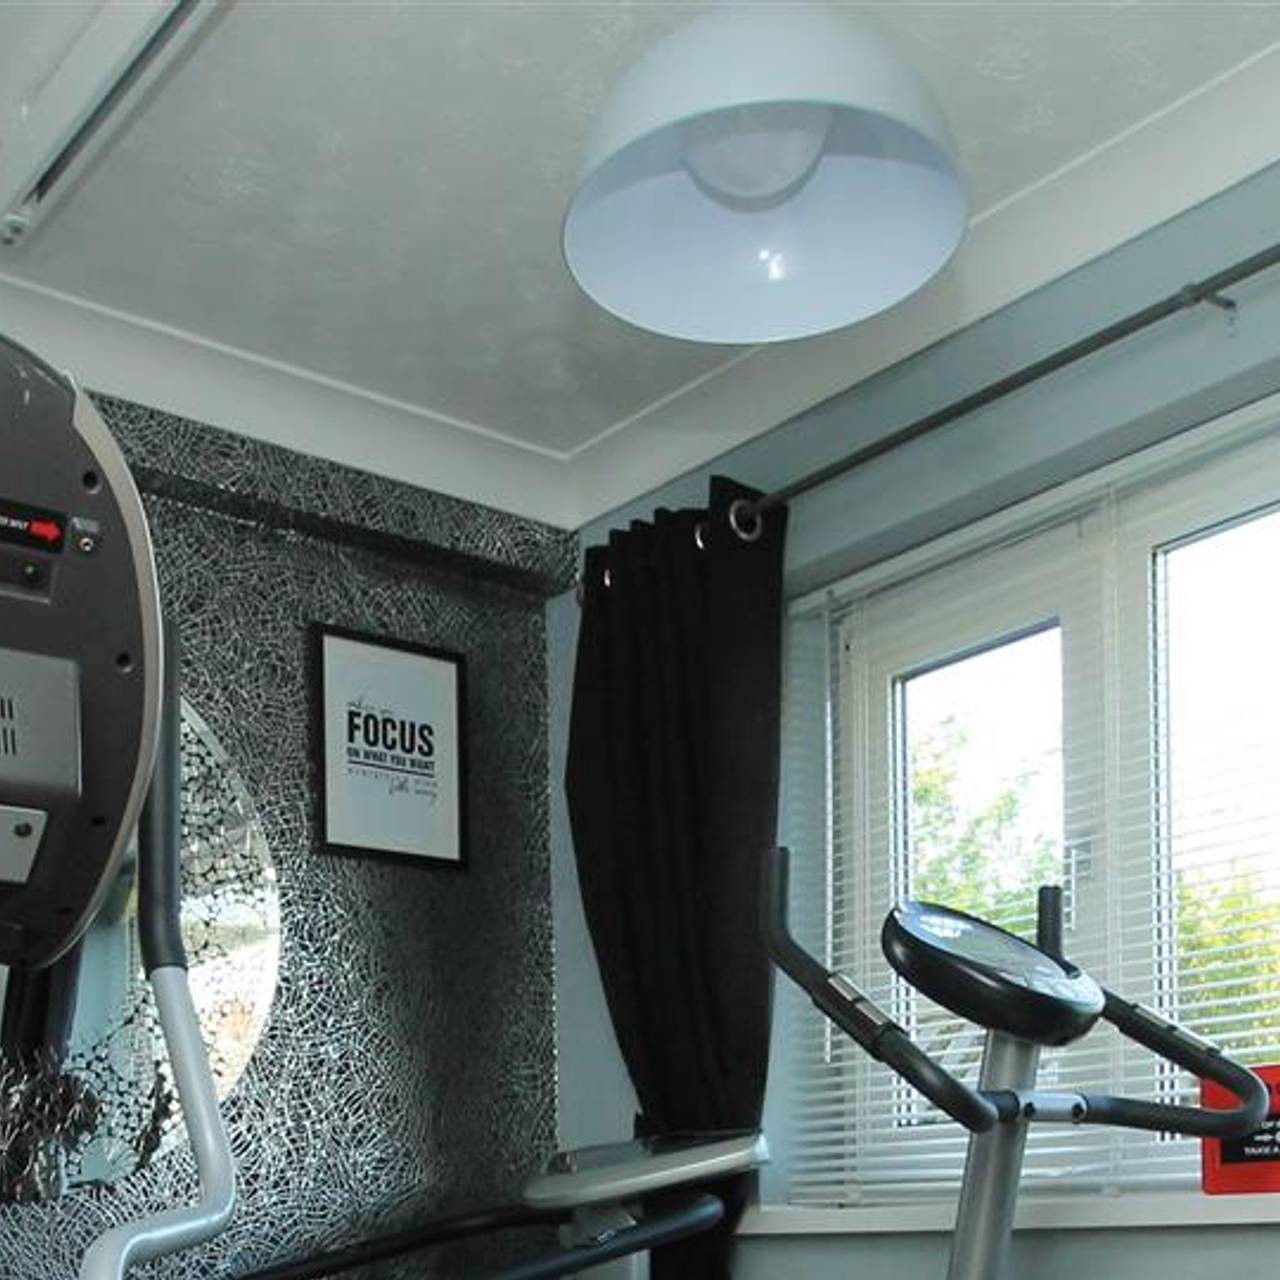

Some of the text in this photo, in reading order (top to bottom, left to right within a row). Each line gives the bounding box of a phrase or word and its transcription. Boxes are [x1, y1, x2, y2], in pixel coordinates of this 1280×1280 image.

[347, 709, 434, 758] FOCUS
[363, 749, 388, 763] WHAT
[390, 753, 406, 767] YOU
[409, 758, 435, 772] WANT
[1244, 1146, 1272, 1156] TAKE
